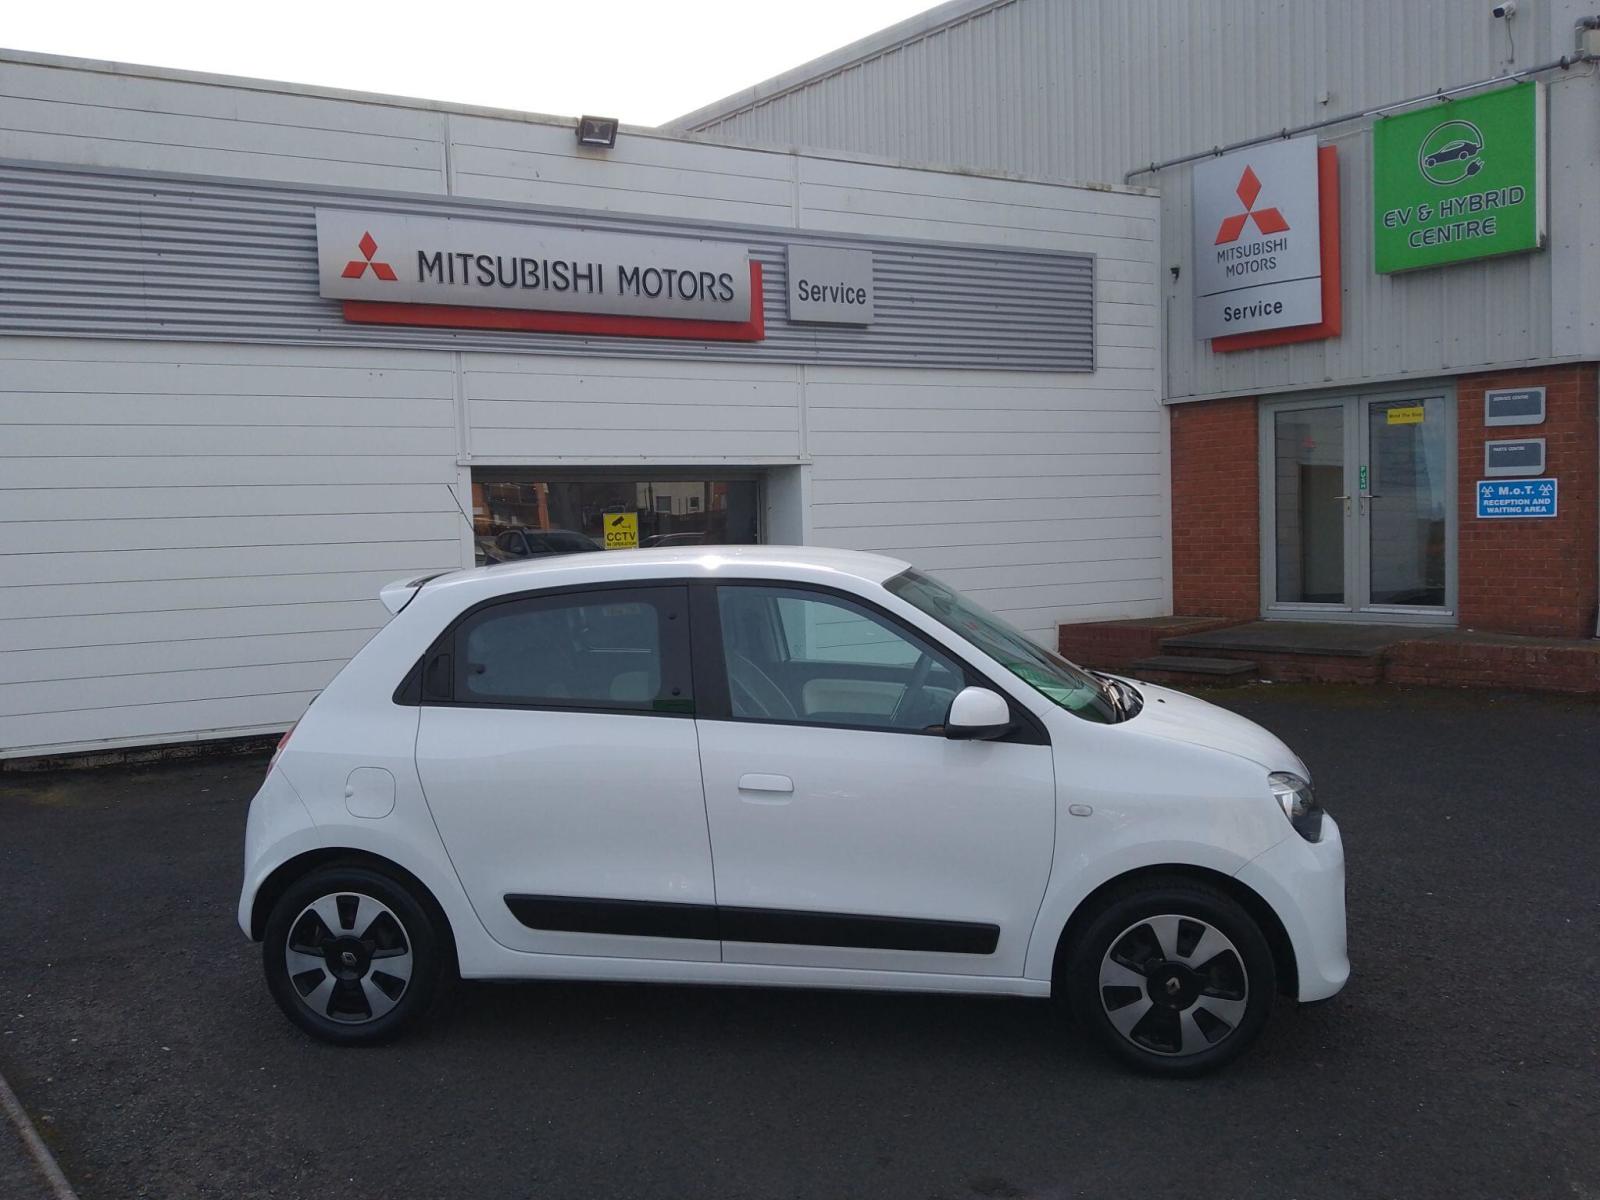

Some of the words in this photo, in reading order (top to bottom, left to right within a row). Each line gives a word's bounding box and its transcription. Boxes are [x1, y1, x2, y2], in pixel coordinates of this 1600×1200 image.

[1384, 208, 1413, 228] EV
[1417, 204, 1433, 222] &
[1440, 186, 1526, 218] HYBRID
[1408, 216, 1497, 248] CENTRE
[1217, 237, 1288, 263] MITSUBISHI
[417, 250, 604, 295] MITSUBISHI
[617, 264, 735, 302] MOTORS
[1226, 256, 1277, 278] MOTORS
[798, 279, 867, 305] Service
[1224, 300, 1283, 322] Service
[1483, 498, 1531, 506] RECEPTION
[1532, 497, 1552, 505] AND
[1498, 485, 1535, 496] M.o.T.
[1486, 506, 1523, 514] WAITING
[1523, 505, 1547, 513] AREA
[606, 531, 636, 541] CCTV
